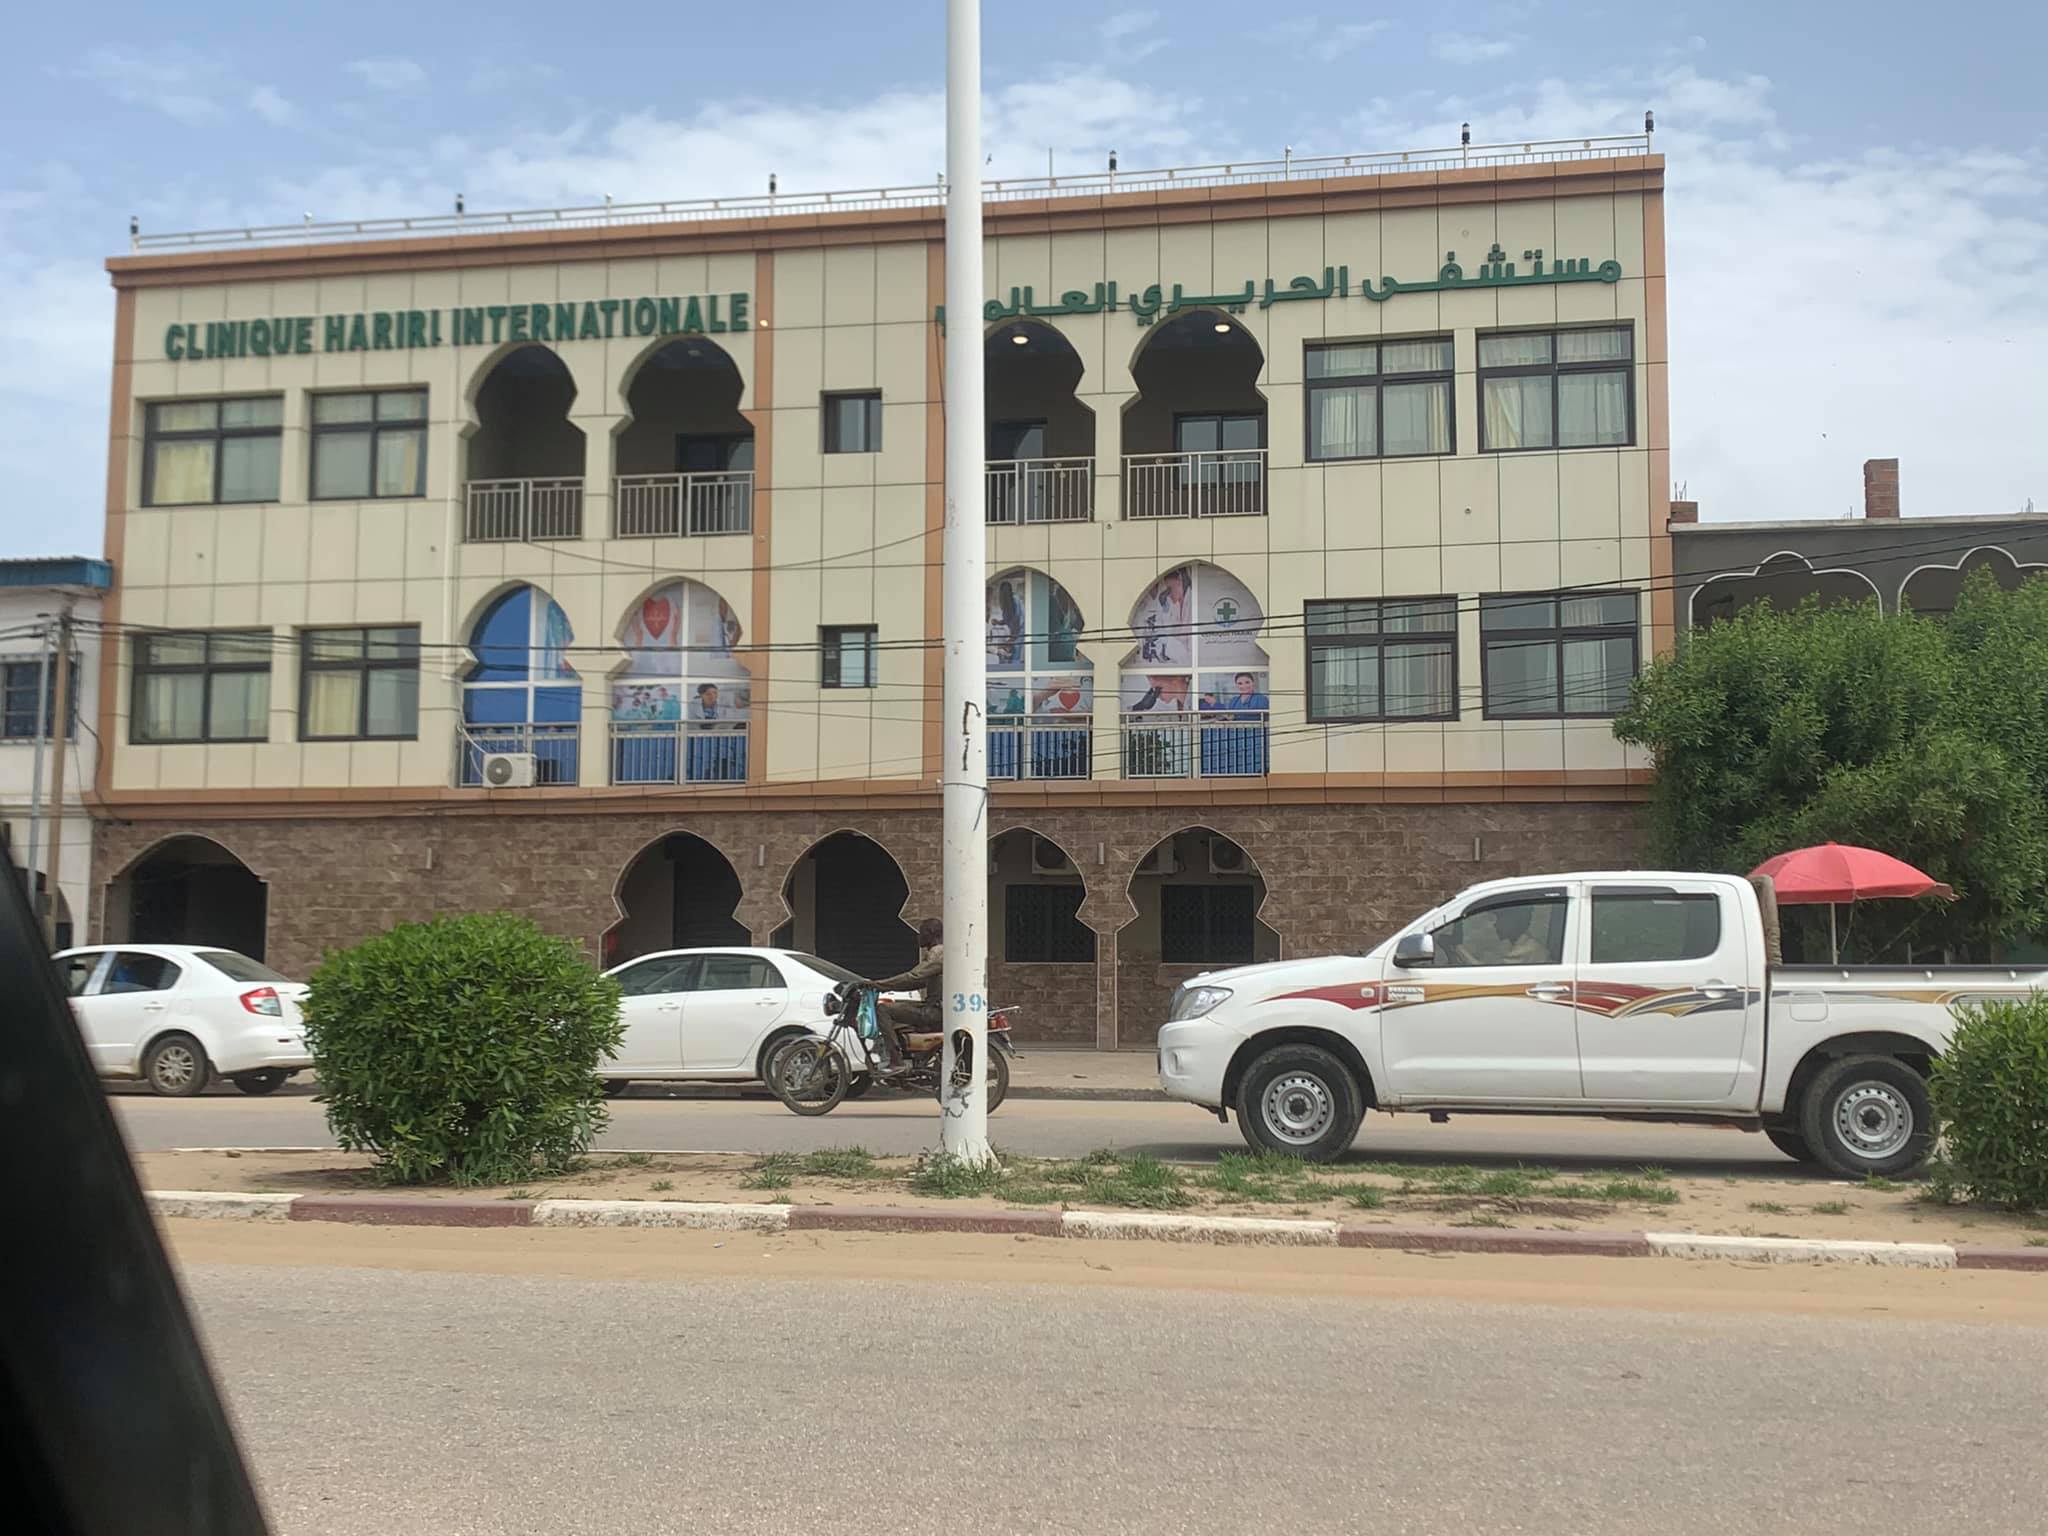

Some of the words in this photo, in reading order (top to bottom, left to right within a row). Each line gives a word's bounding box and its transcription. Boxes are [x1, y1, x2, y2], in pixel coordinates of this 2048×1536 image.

[1129, 265, 1349, 327] الحريري
[1362, 243, 1622, 302] مستشفى
[164, 316, 314, 362] CLINIQUE
[324, 309, 442, 353] HARIRI
[452, 292, 749, 347] INTERNATIONALE
[951, 992, 983, 1013] 39
